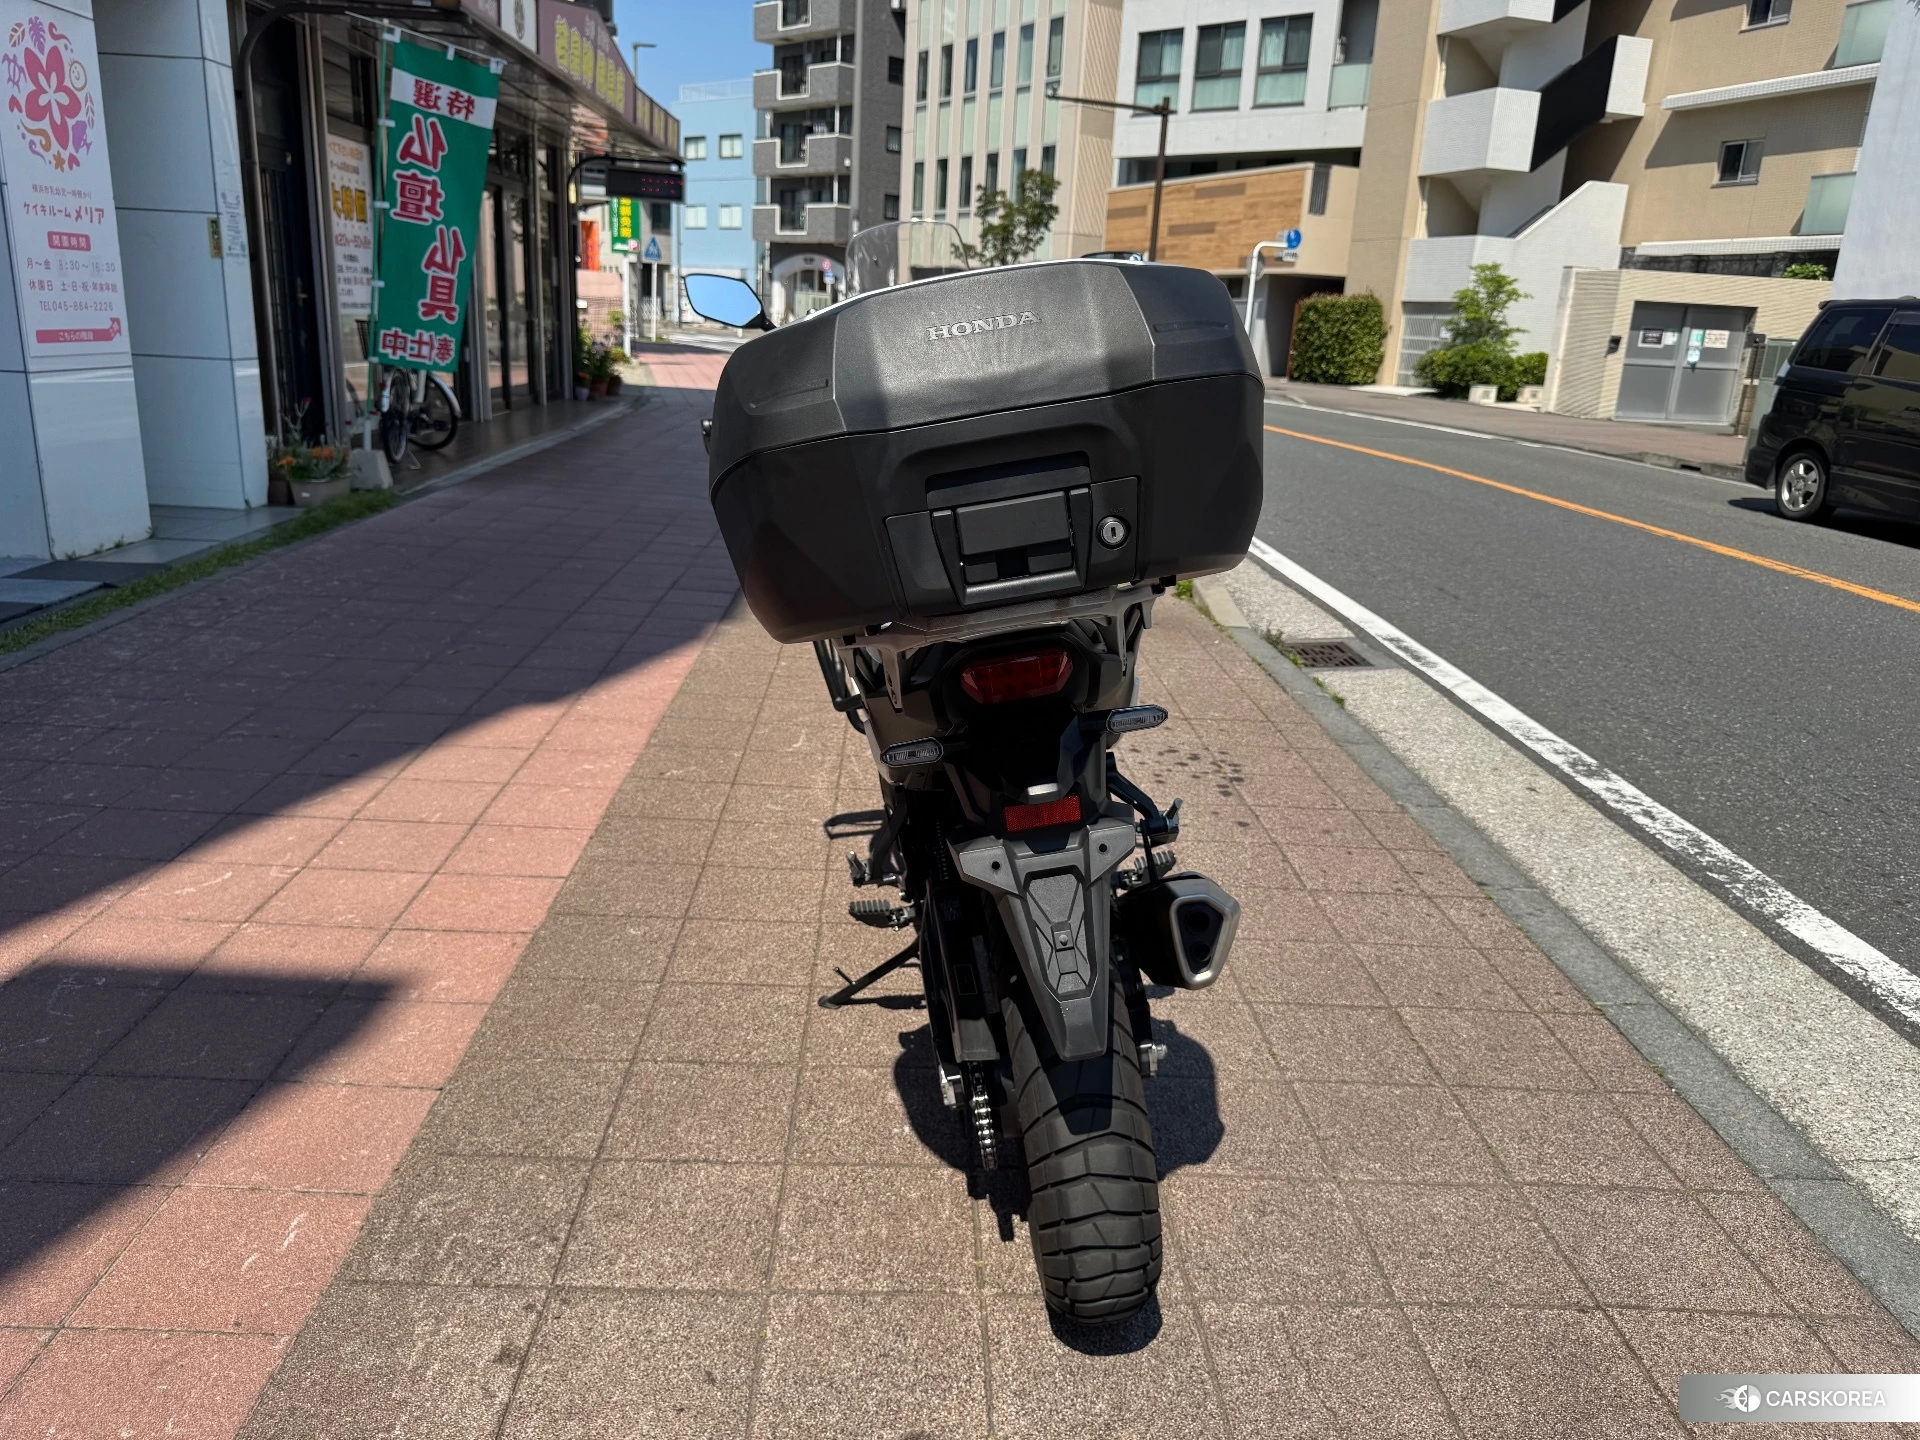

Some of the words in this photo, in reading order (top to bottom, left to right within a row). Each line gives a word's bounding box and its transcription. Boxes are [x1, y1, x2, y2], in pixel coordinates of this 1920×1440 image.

[23, 201, 71, 218] ケイキルーム
[75, 205, 105, 225] メリア
[926, 310, 1042, 341] HONDA
